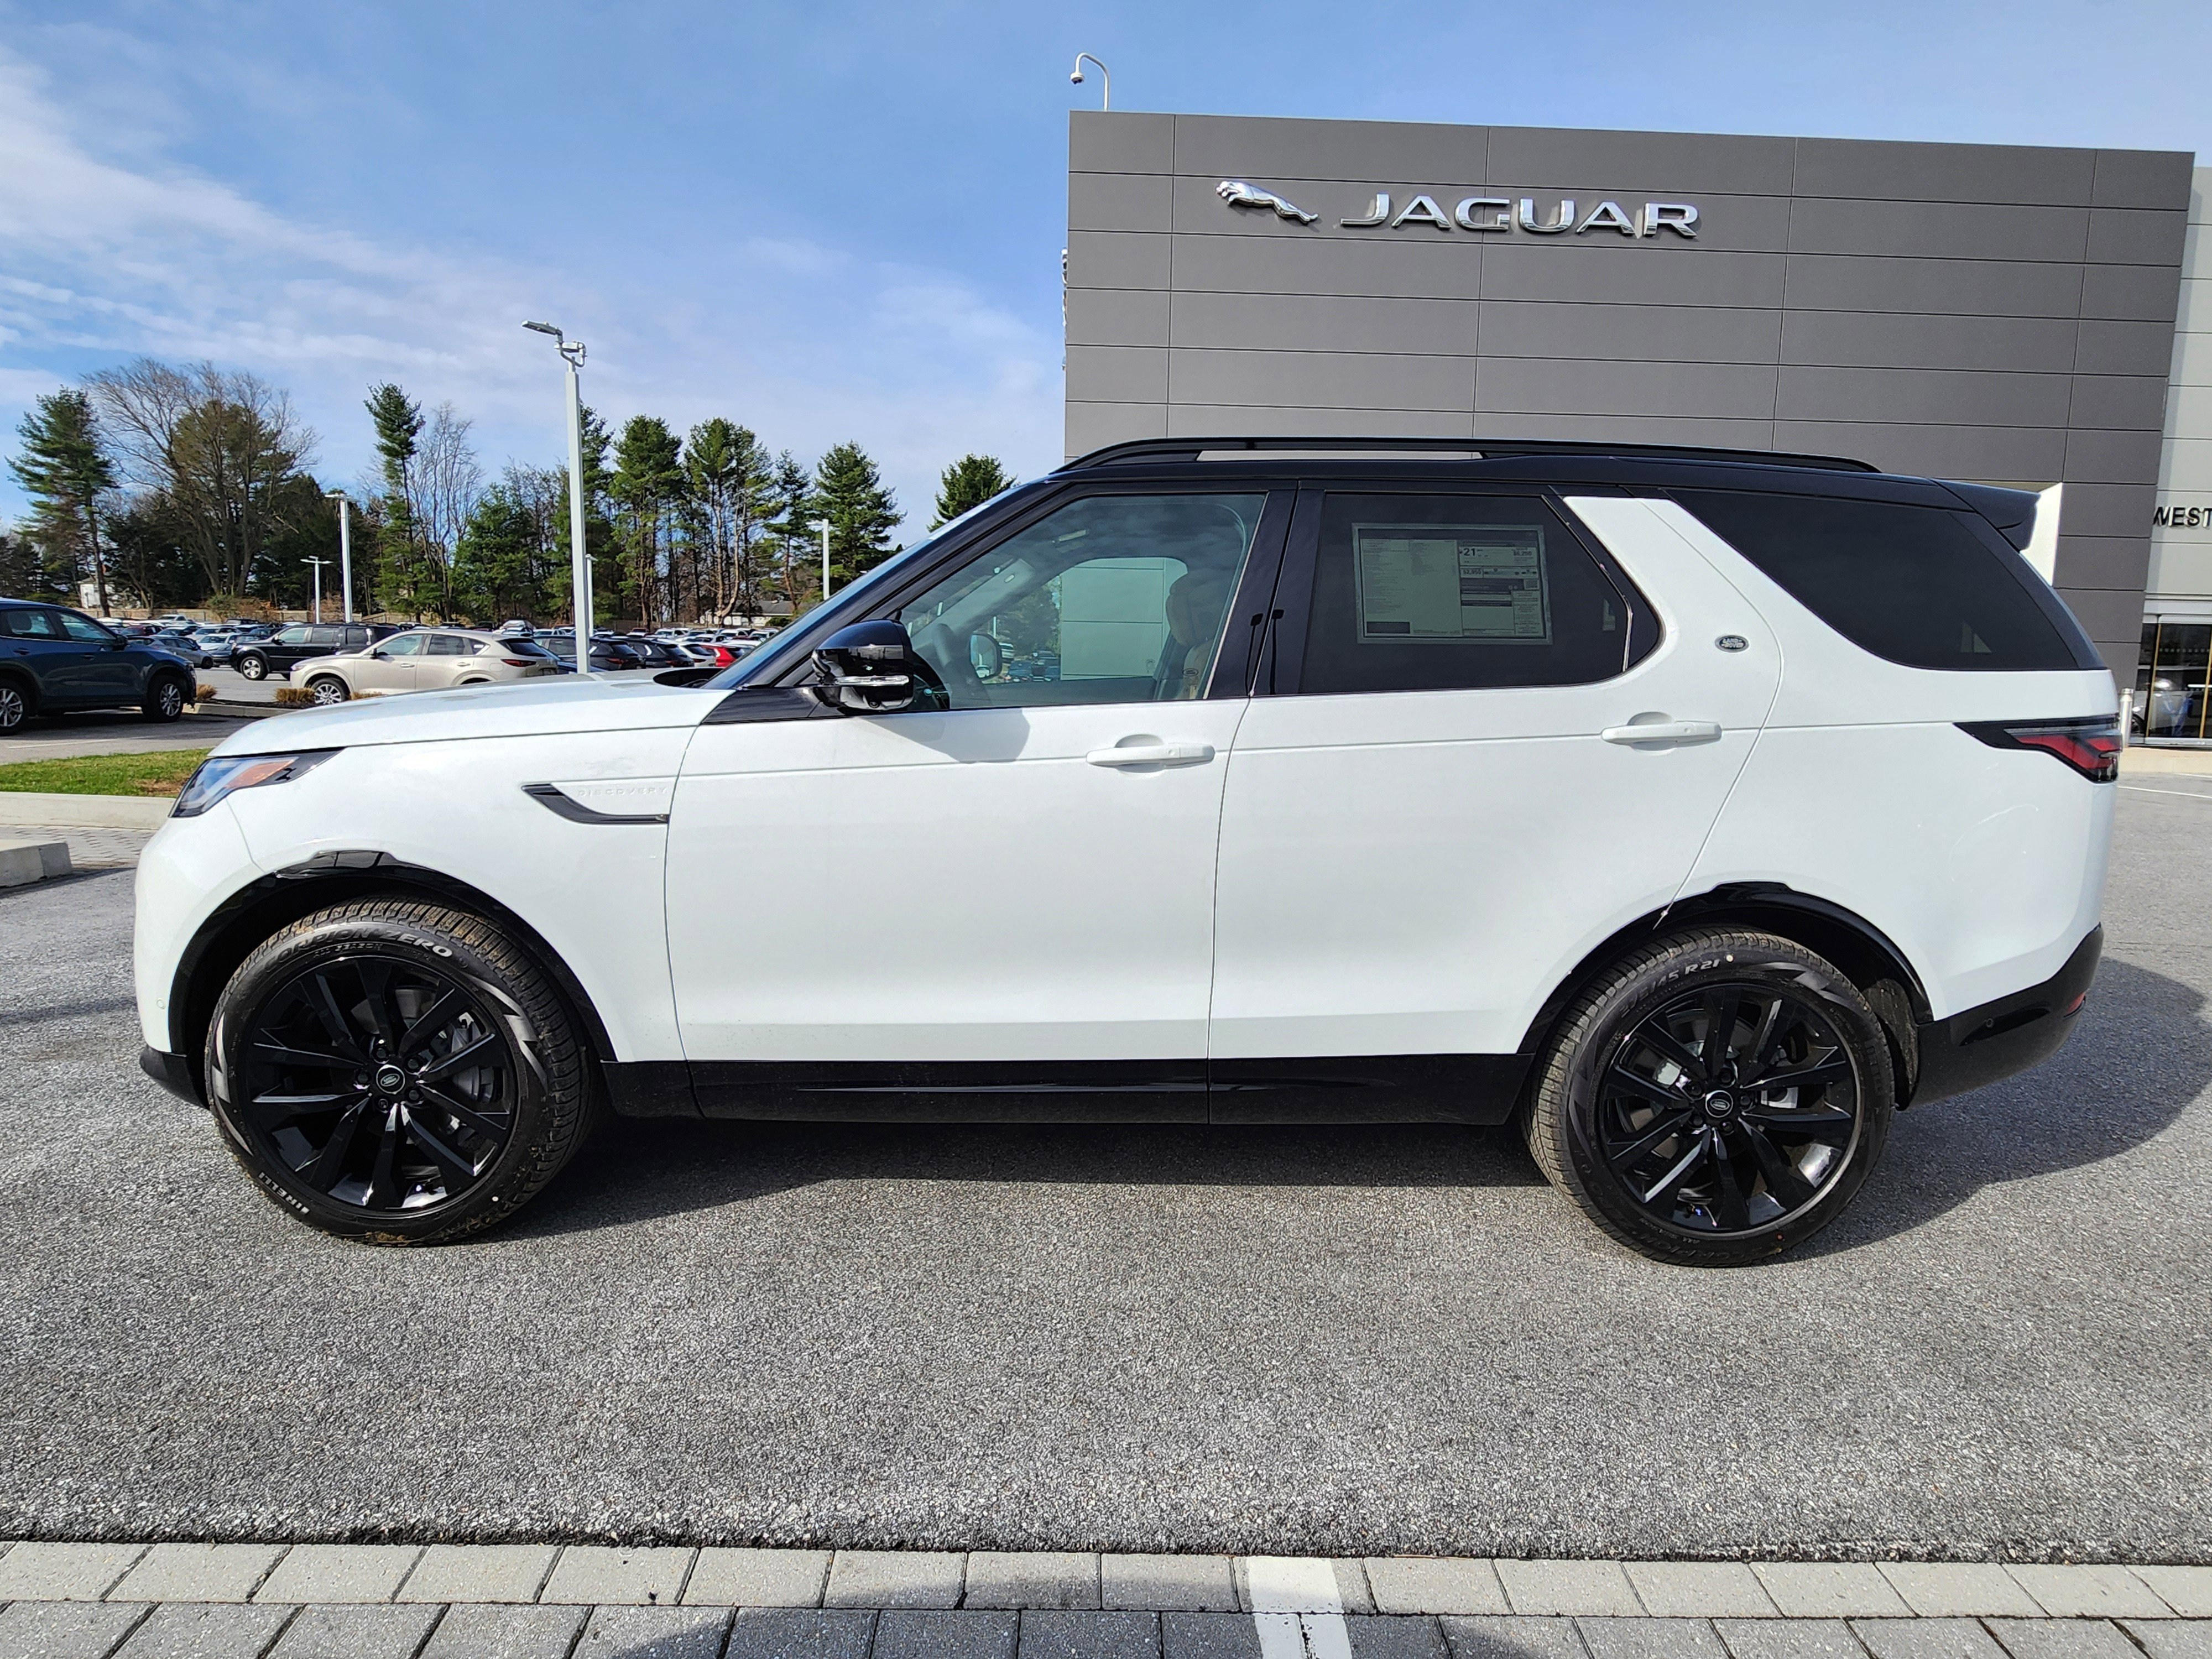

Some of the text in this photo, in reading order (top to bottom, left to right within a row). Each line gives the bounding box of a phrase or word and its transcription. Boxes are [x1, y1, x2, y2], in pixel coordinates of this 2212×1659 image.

[1340, 193, 1697, 238] JAGUAR
[578, 787, 667, 796] DISCOVERY
[380, 930, 452, 957] ZERO
[1685, 959, 1720, 974] R21
